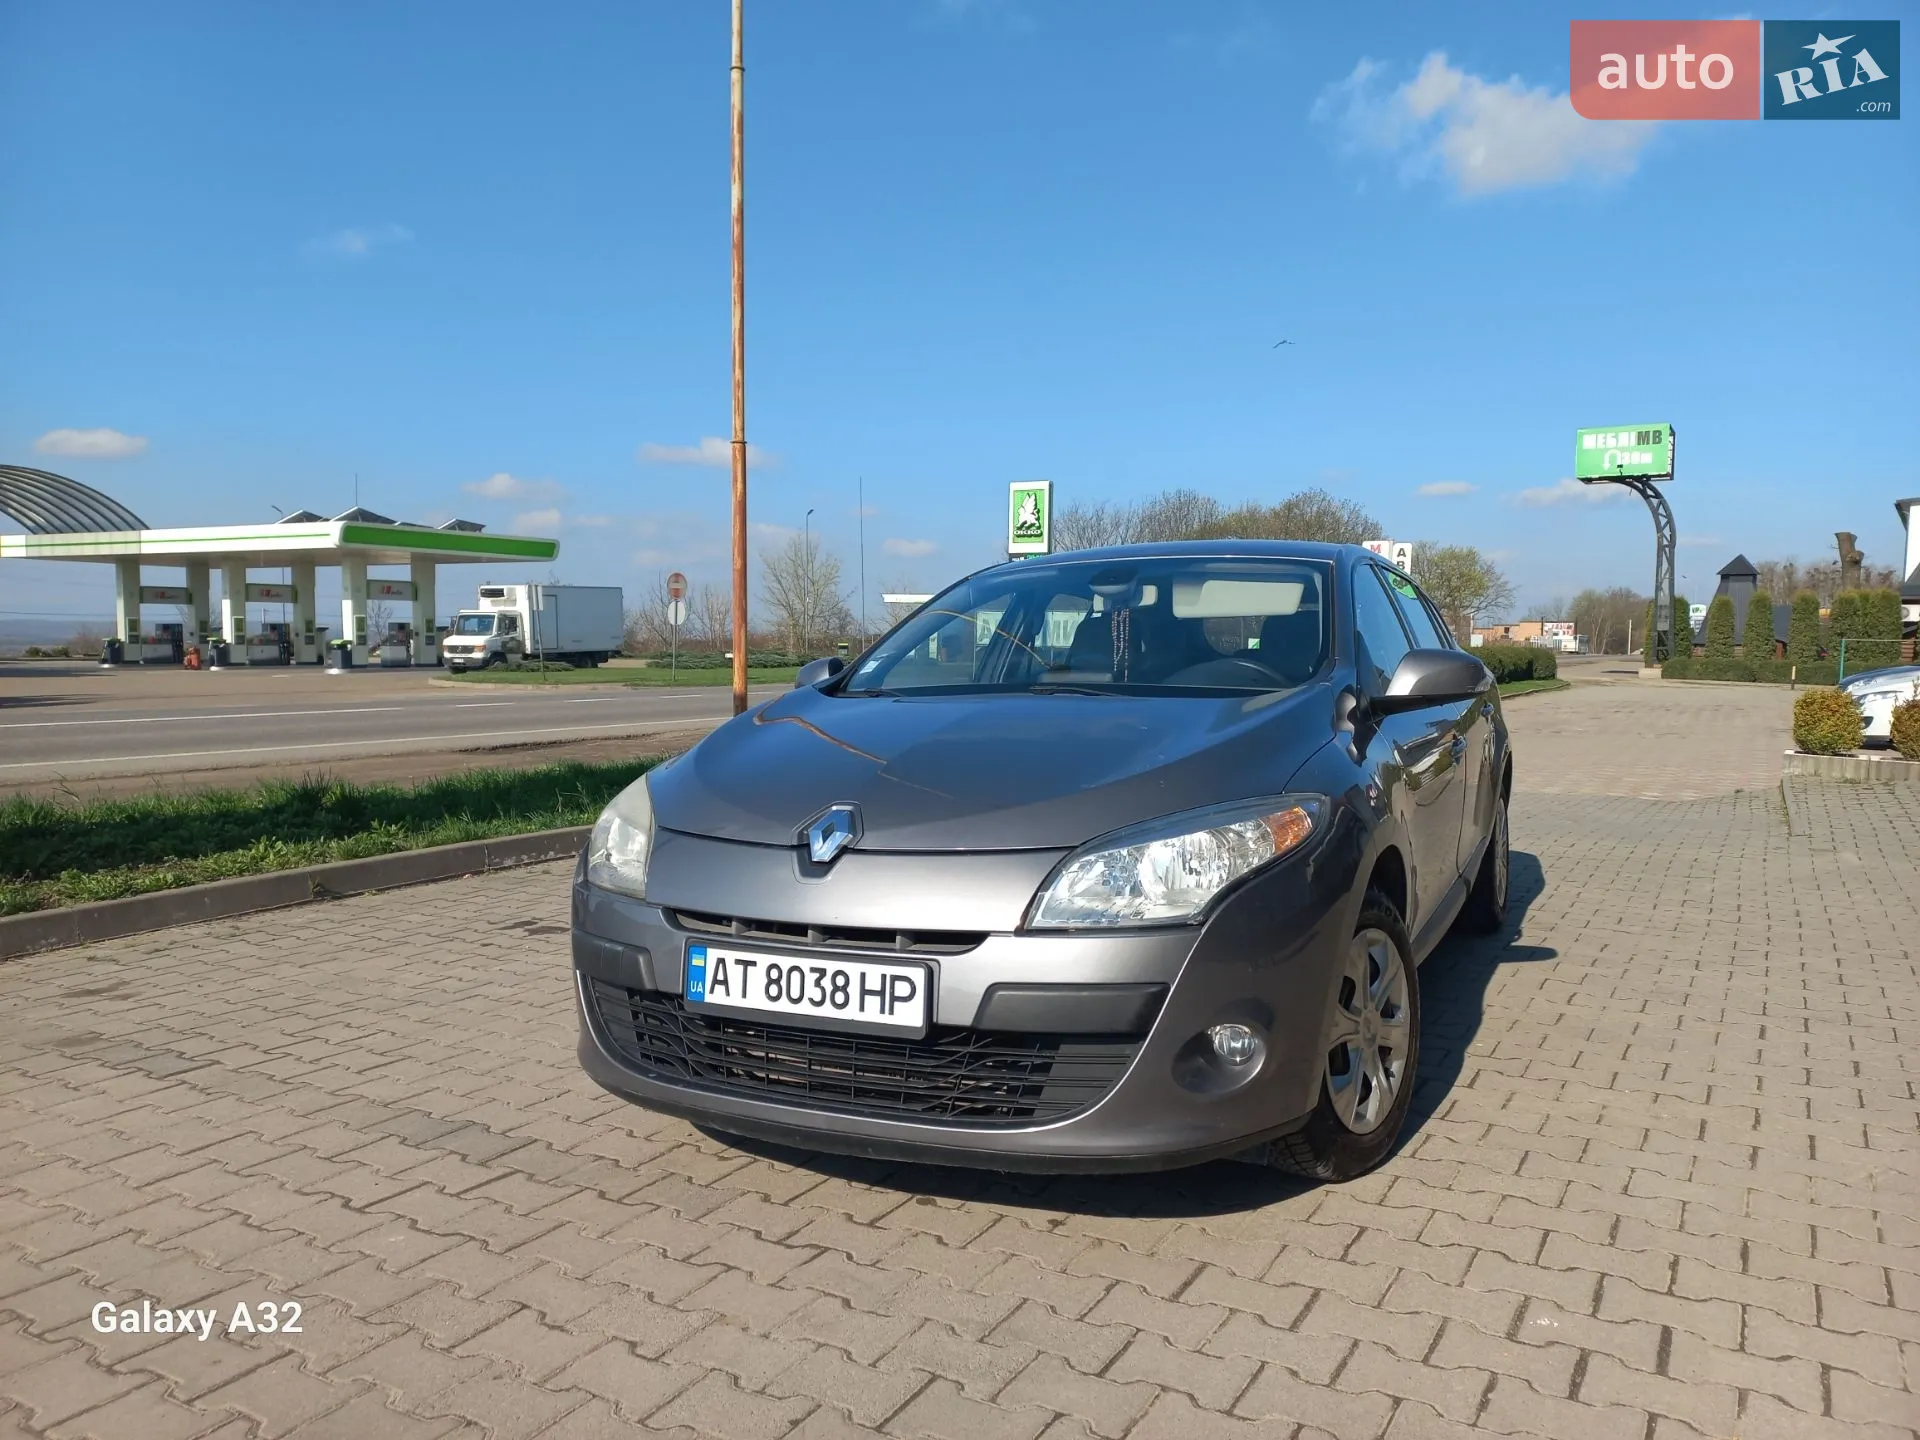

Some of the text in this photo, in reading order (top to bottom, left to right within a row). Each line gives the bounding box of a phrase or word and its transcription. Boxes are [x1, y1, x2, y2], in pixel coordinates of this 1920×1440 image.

[690, 980, 704, 993] UA
[709, 957, 917, 1016] AT 8038 HP
